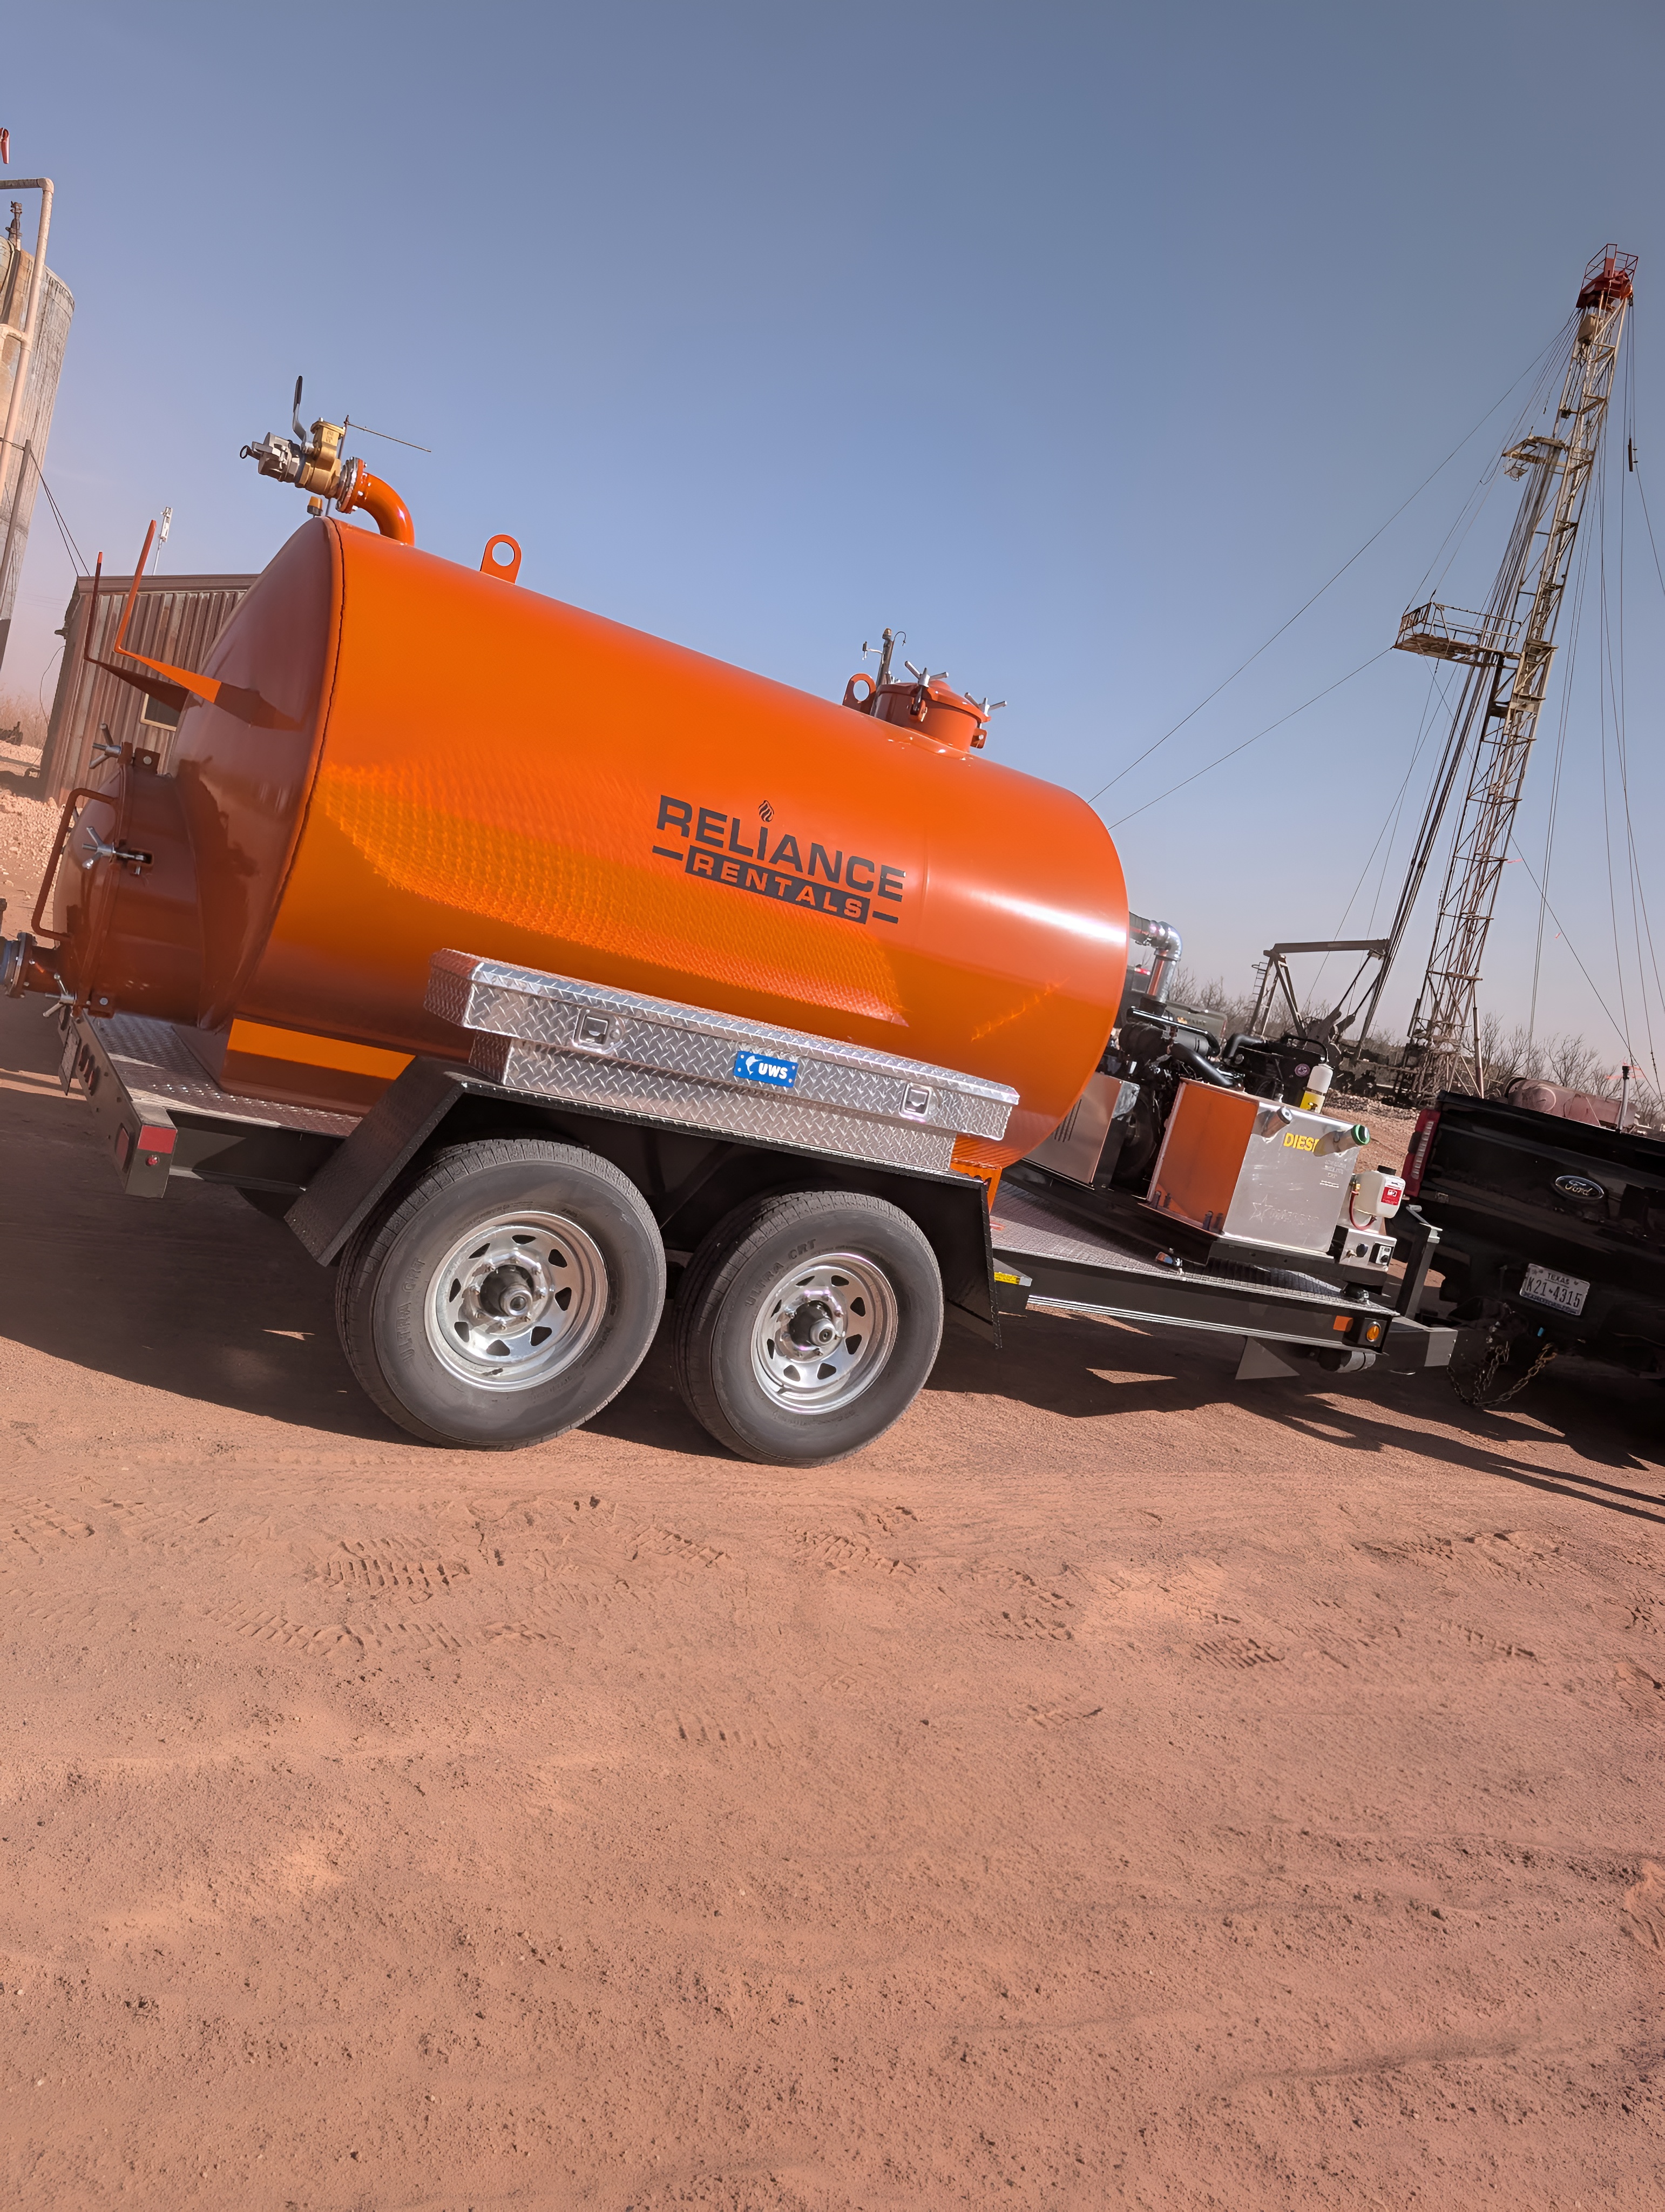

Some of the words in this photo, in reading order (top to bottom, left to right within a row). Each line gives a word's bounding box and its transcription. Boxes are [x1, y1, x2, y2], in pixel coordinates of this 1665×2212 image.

[656, 795, 906, 902] RELIANCE
[693, 855, 863, 918] RENTALS
[759, 1062, 788, 1079] UWS
[1565, 1180, 1593, 1196] Ford
[1548, 1273, 1569, 1284] TEXAS
